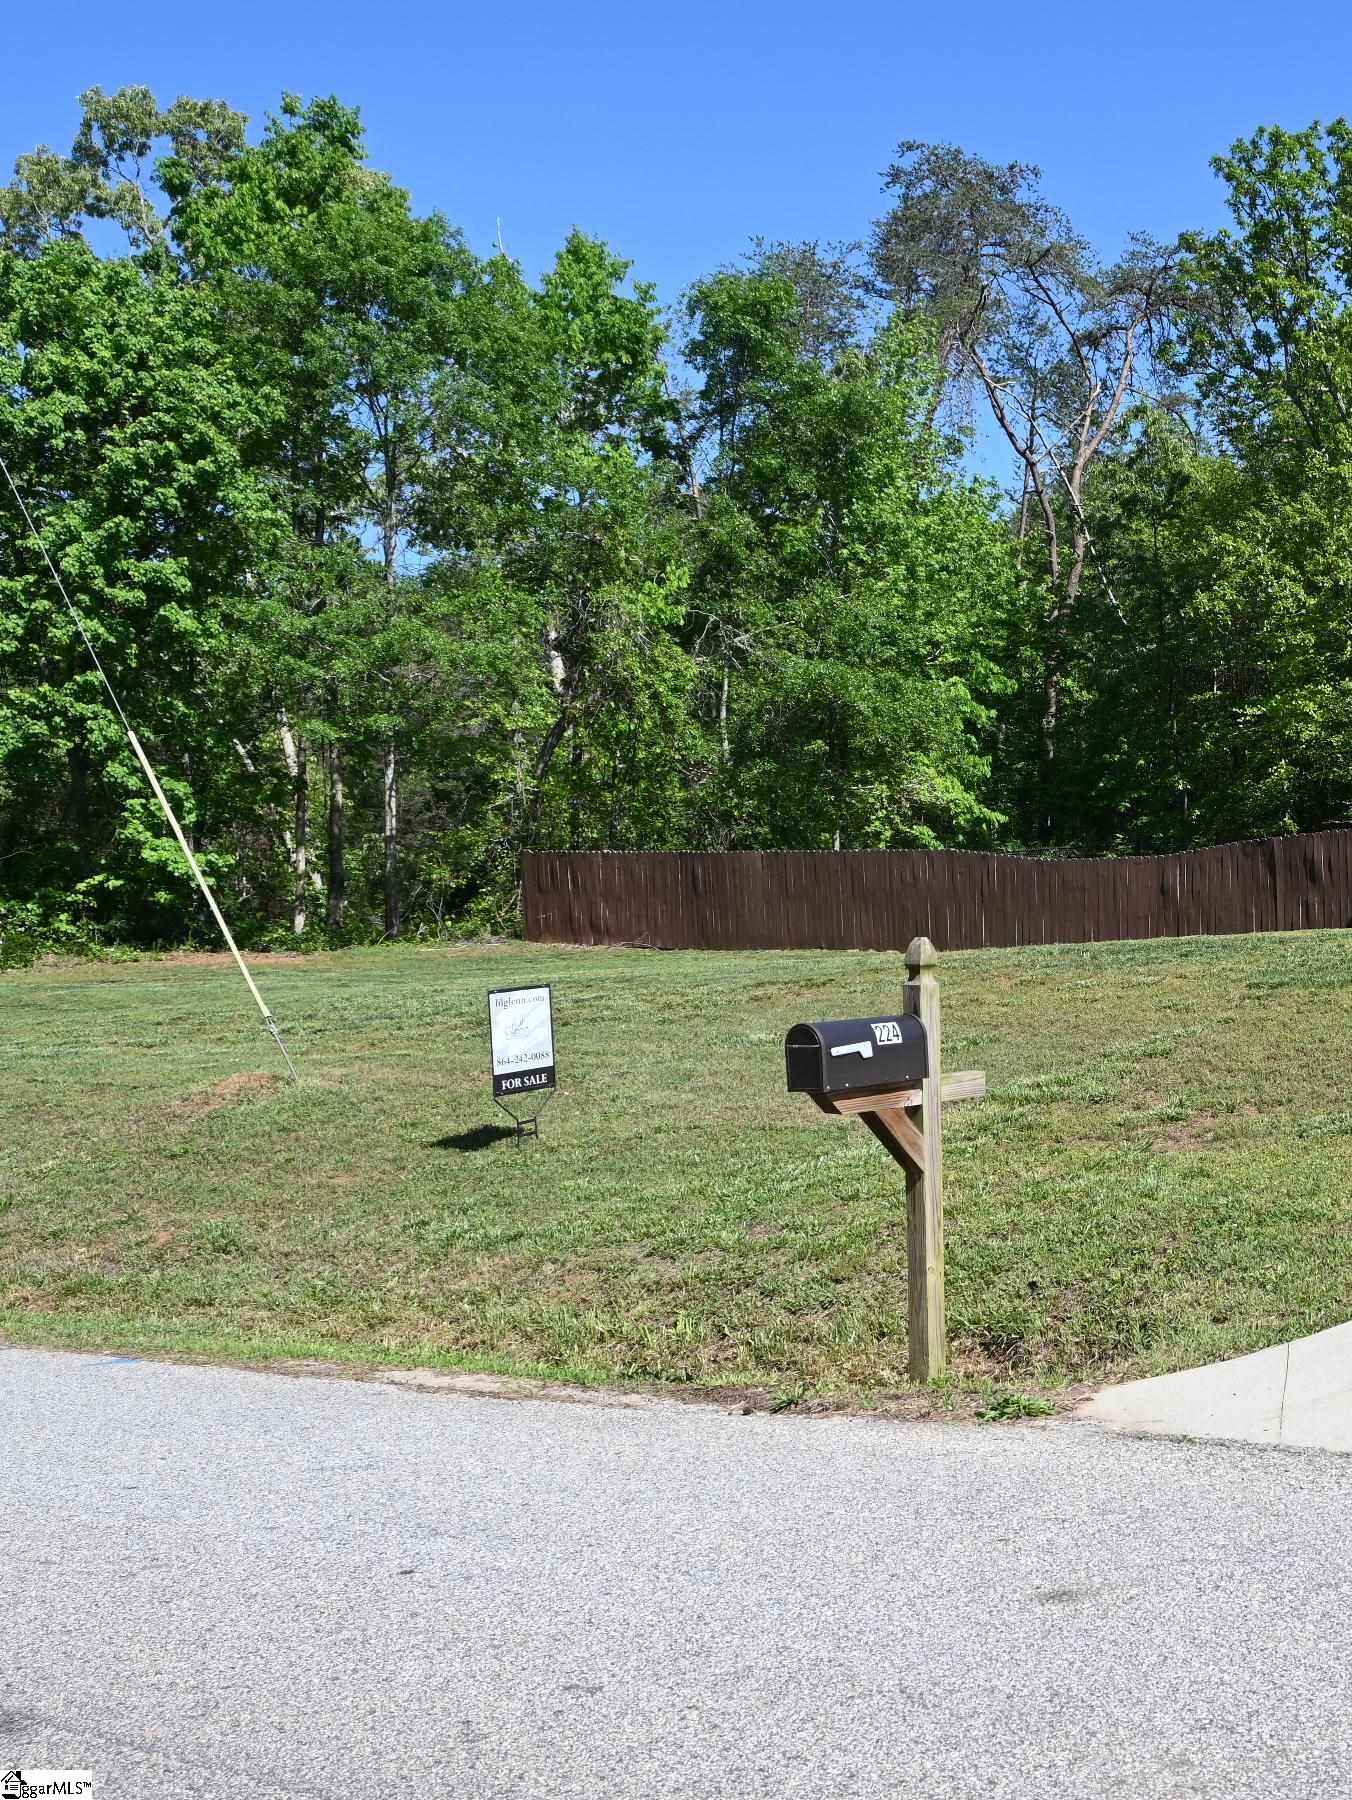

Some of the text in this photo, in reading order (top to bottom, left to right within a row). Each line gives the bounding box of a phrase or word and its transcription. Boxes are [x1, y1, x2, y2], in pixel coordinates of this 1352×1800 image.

[875, 1024, 900, 1043] 224
[501, 1073, 548, 1090] FOR SALE
